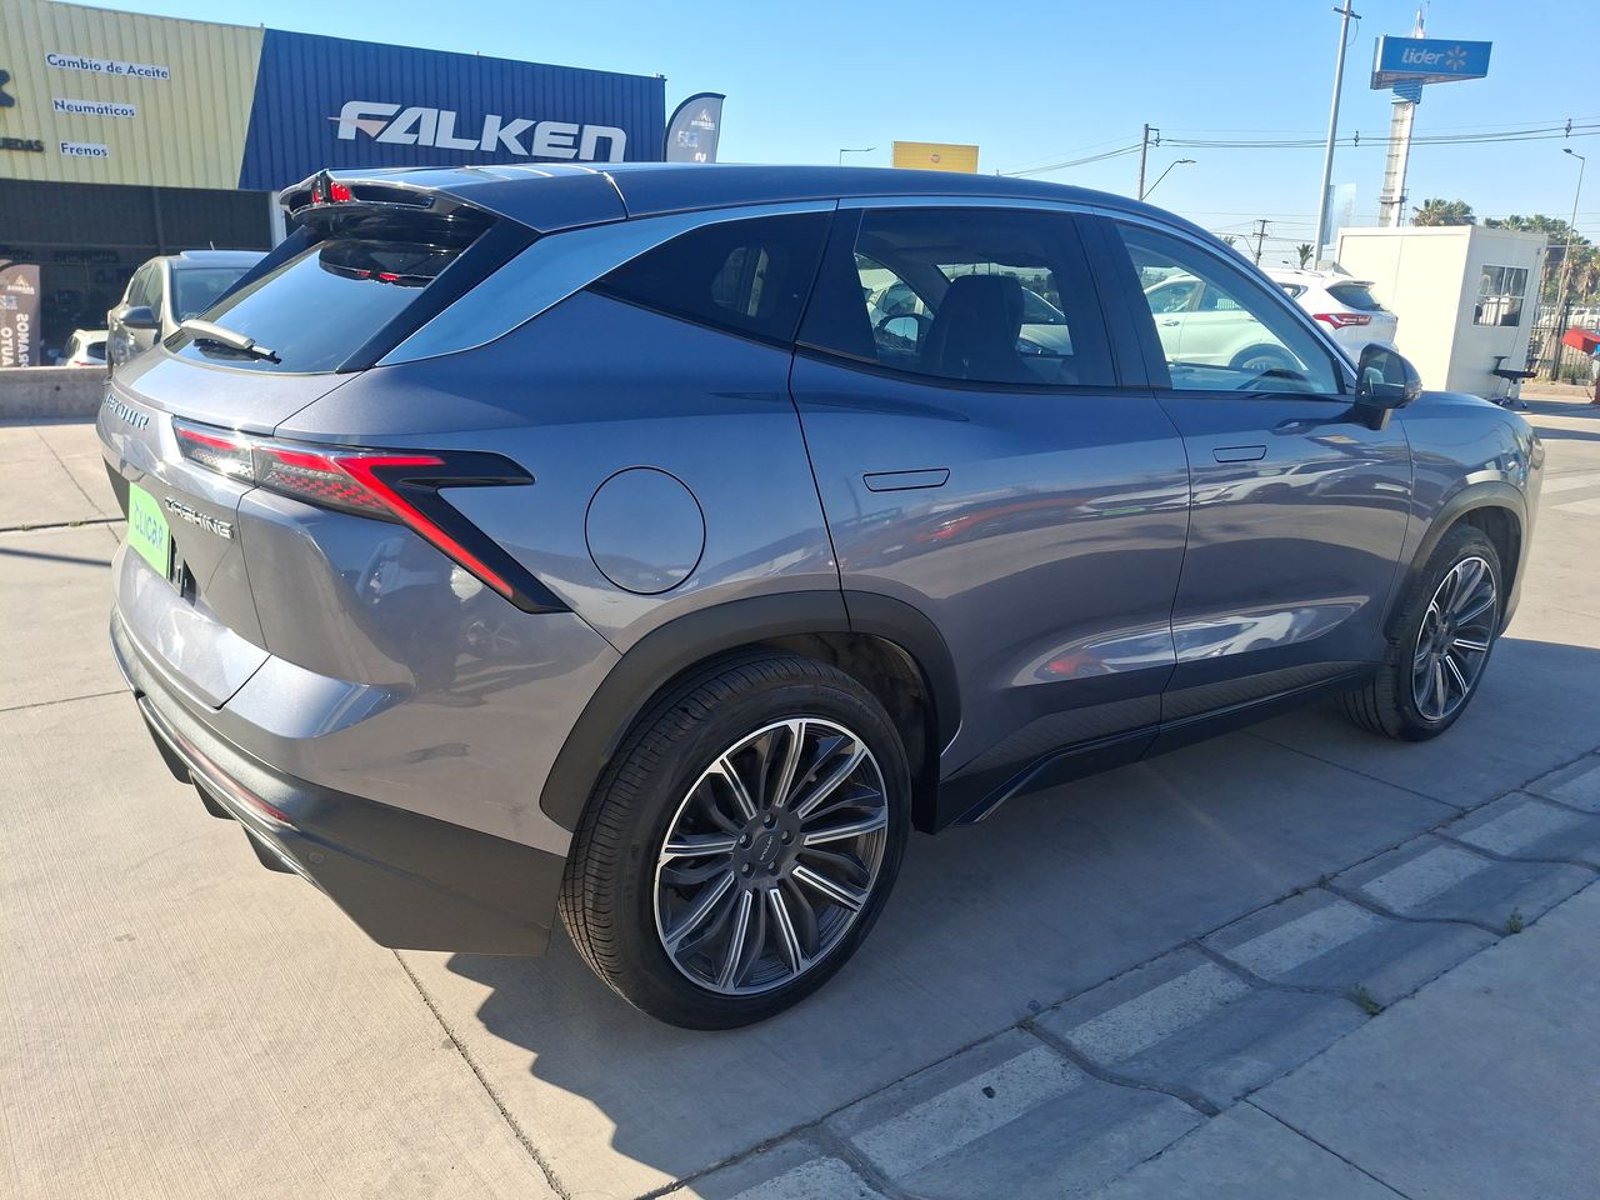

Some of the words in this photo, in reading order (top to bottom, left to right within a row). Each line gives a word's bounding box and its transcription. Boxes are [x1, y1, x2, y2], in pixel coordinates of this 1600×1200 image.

[46, 54, 102, 71] Cambio
[106, 62, 122, 74] de
[127, 65, 169, 79] Aceite
[337, 100, 627, 163] FALKEN
[61, 142, 108, 157] Frenos
